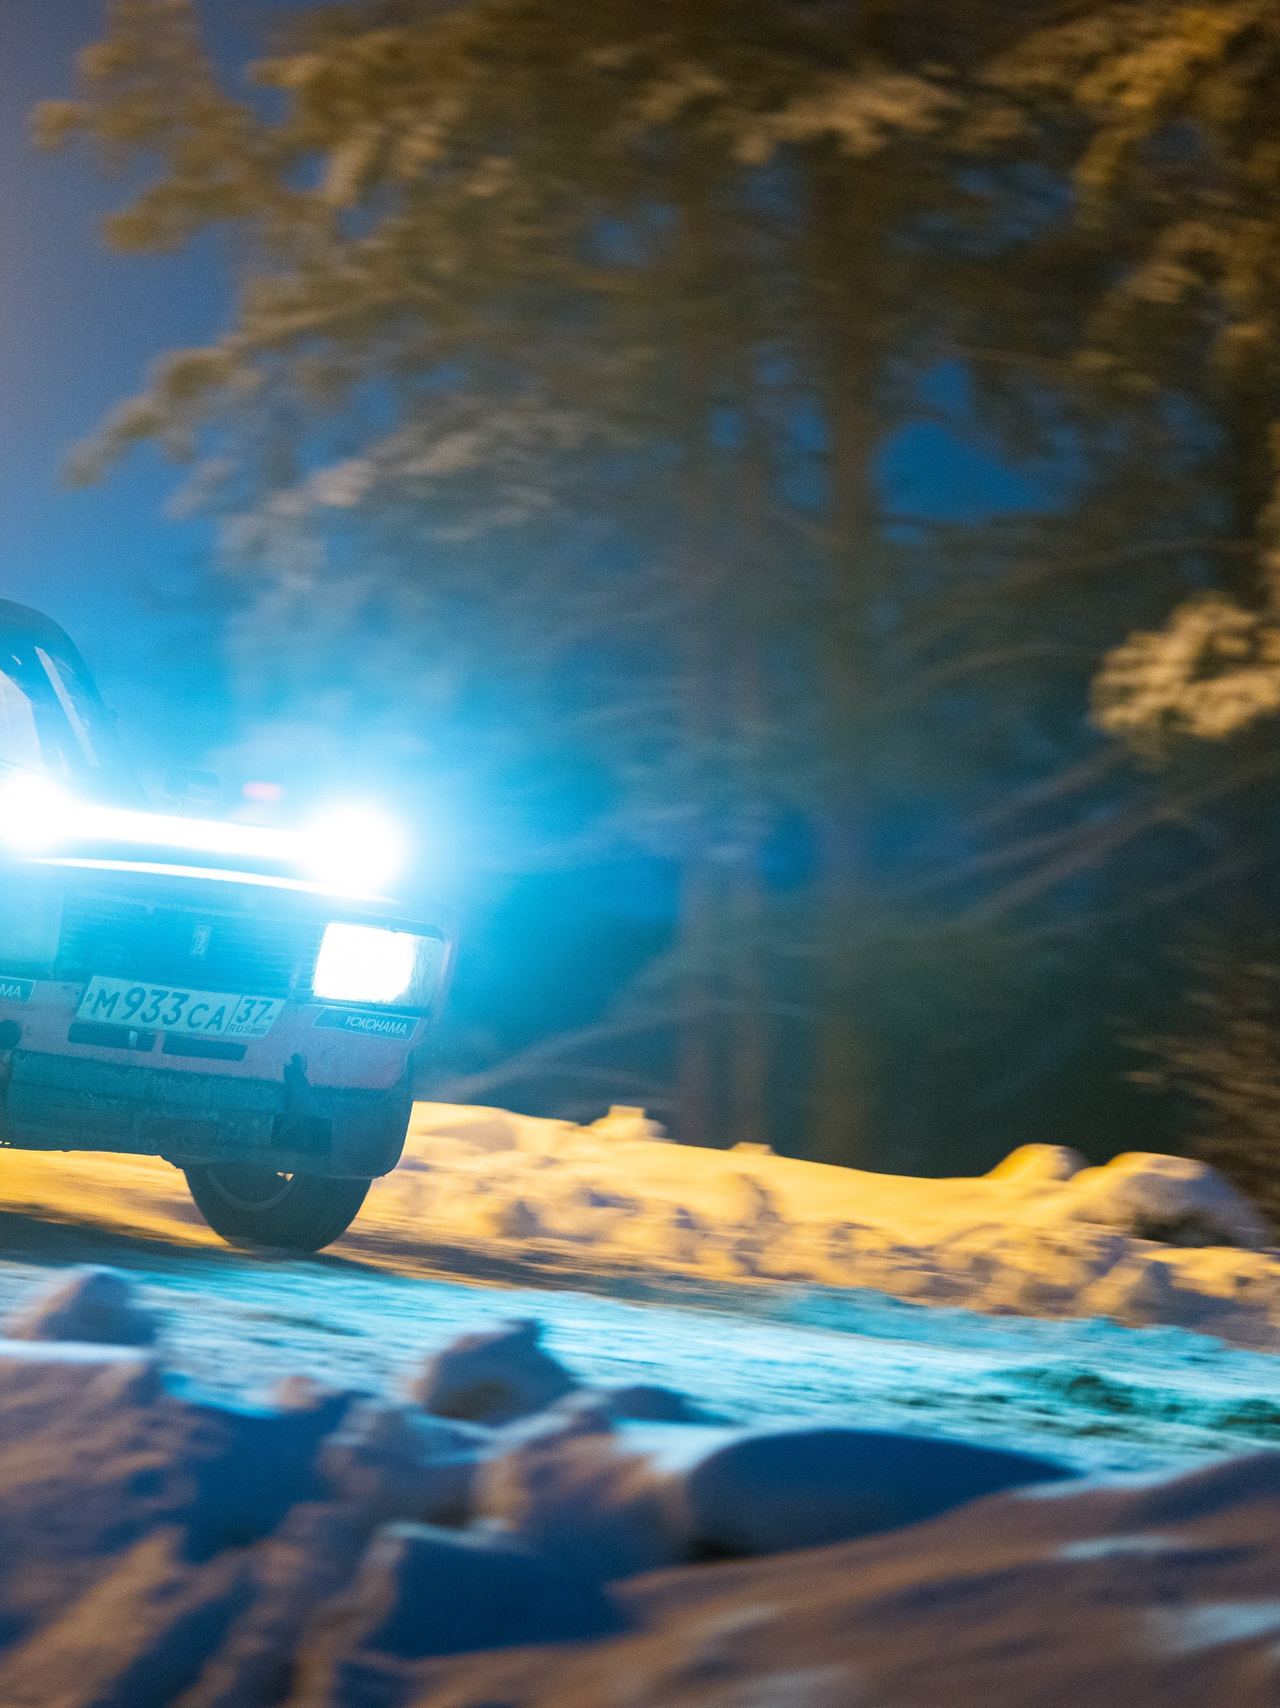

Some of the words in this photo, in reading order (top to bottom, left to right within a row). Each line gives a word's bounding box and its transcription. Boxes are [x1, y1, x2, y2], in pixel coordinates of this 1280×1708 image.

[236, 998, 274, 1024] 37
[227, 1023, 251, 1034] RUS
[344, 1015, 408, 1035] YOKOHAMA
